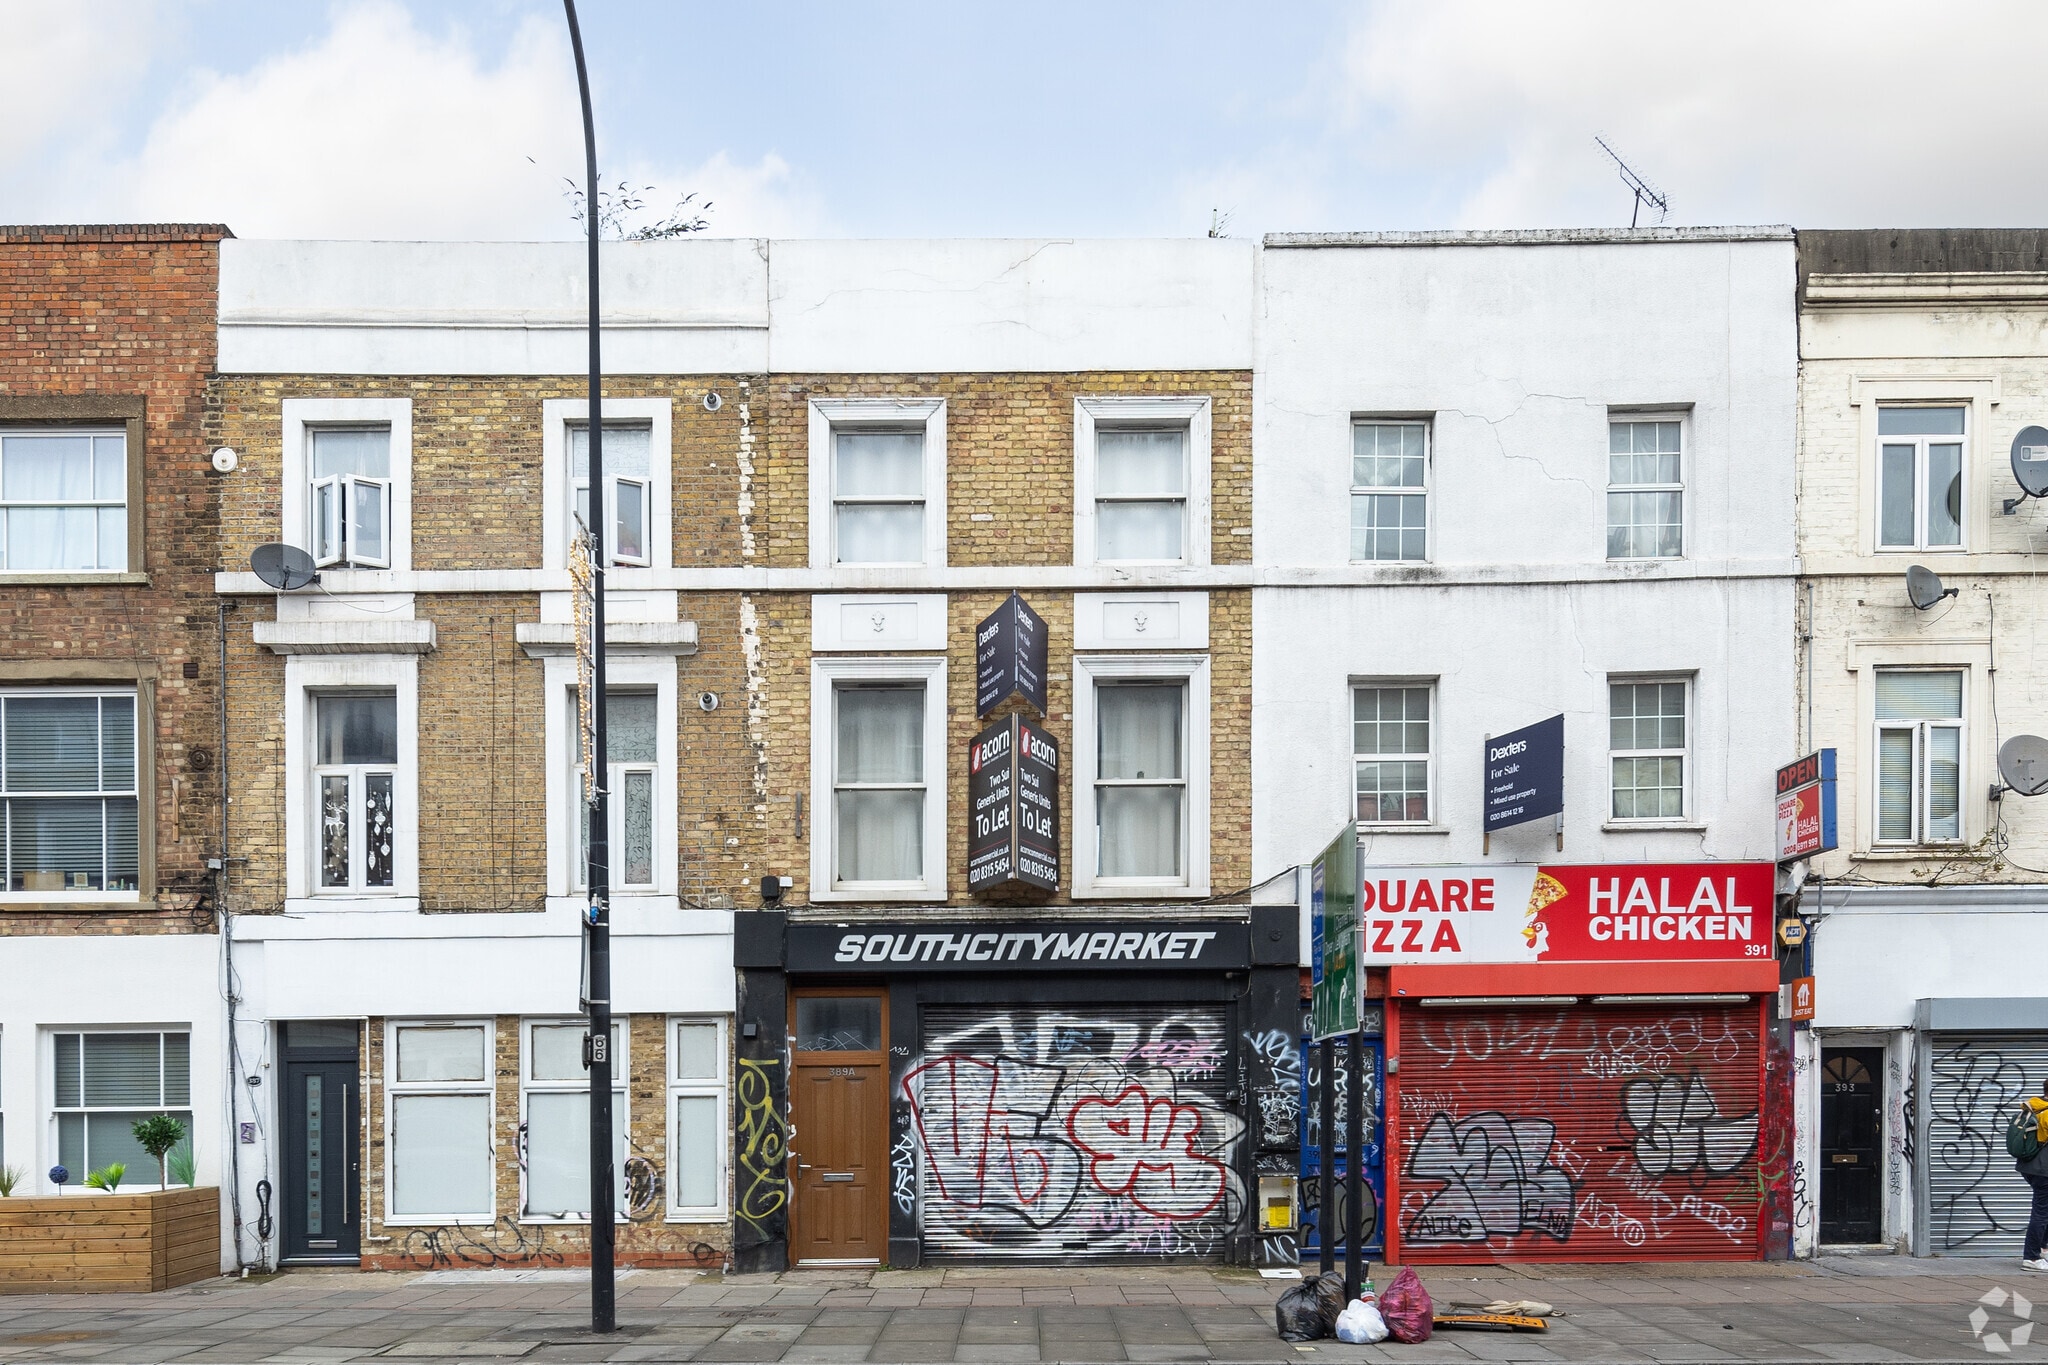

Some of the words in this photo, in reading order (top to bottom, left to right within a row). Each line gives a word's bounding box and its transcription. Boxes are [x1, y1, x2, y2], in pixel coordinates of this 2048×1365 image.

[979, 622, 999, 647] Dexters
[981, 730, 1010, 762] acorn
[1031, 735, 1056, 766] acorn
[1490, 740, 1527, 761] Dexters
[989, 774, 1001, 787] Two
[1001, 767, 1010, 782] Sui
[1020, 767, 1031, 784] Two
[1491, 768, 1503, 779] For
[1504, 763, 1520, 776] Sale
[1778, 757, 1816, 791] OPEN
[976, 792, 996, 810] Generis
[996, 786, 1010, 801] Units
[1020, 784, 1038, 804] Generis
[1038, 793, 1051, 810] Units
[1493, 782, 1514, 793] Freehold
[1516, 788, 1537, 800] property
[1778, 798, 1796, 812] SQUARE
[975, 814, 990, 838] To
[992, 804, 1010, 832] Let
[1020, 802, 1034, 830] To
[1036, 809, 1052, 839] Let
[1490, 812, 1500, 821] 020
[1798, 815, 1819, 830] HALAL
[1798, 825, 1819, 838] CHICKEN
[969, 868, 980, 884] 020
[981, 862, 994, 880] 8315
[994, 856, 1010, 875] 5454
[1020, 857, 1031, 874] 020
[1031, 861, 1044, 878] 8315
[1044, 866, 1057, 883] 5454
[1364, 878, 1495, 913] UARE
[1588, 877, 1753, 915] HALAL
[1588, 915, 1751, 941] CHICKEN
[834, 931, 1217, 962] SOUTHCITYMARKET
[1745, 944, 1768, 956] 391
[1794, 1008, 1804, 1017] JUST
[1804, 1007, 1813, 1015] EAT
[829, 1067, 856, 1077] 389A
[1835, 1083, 1855, 1092] 393
